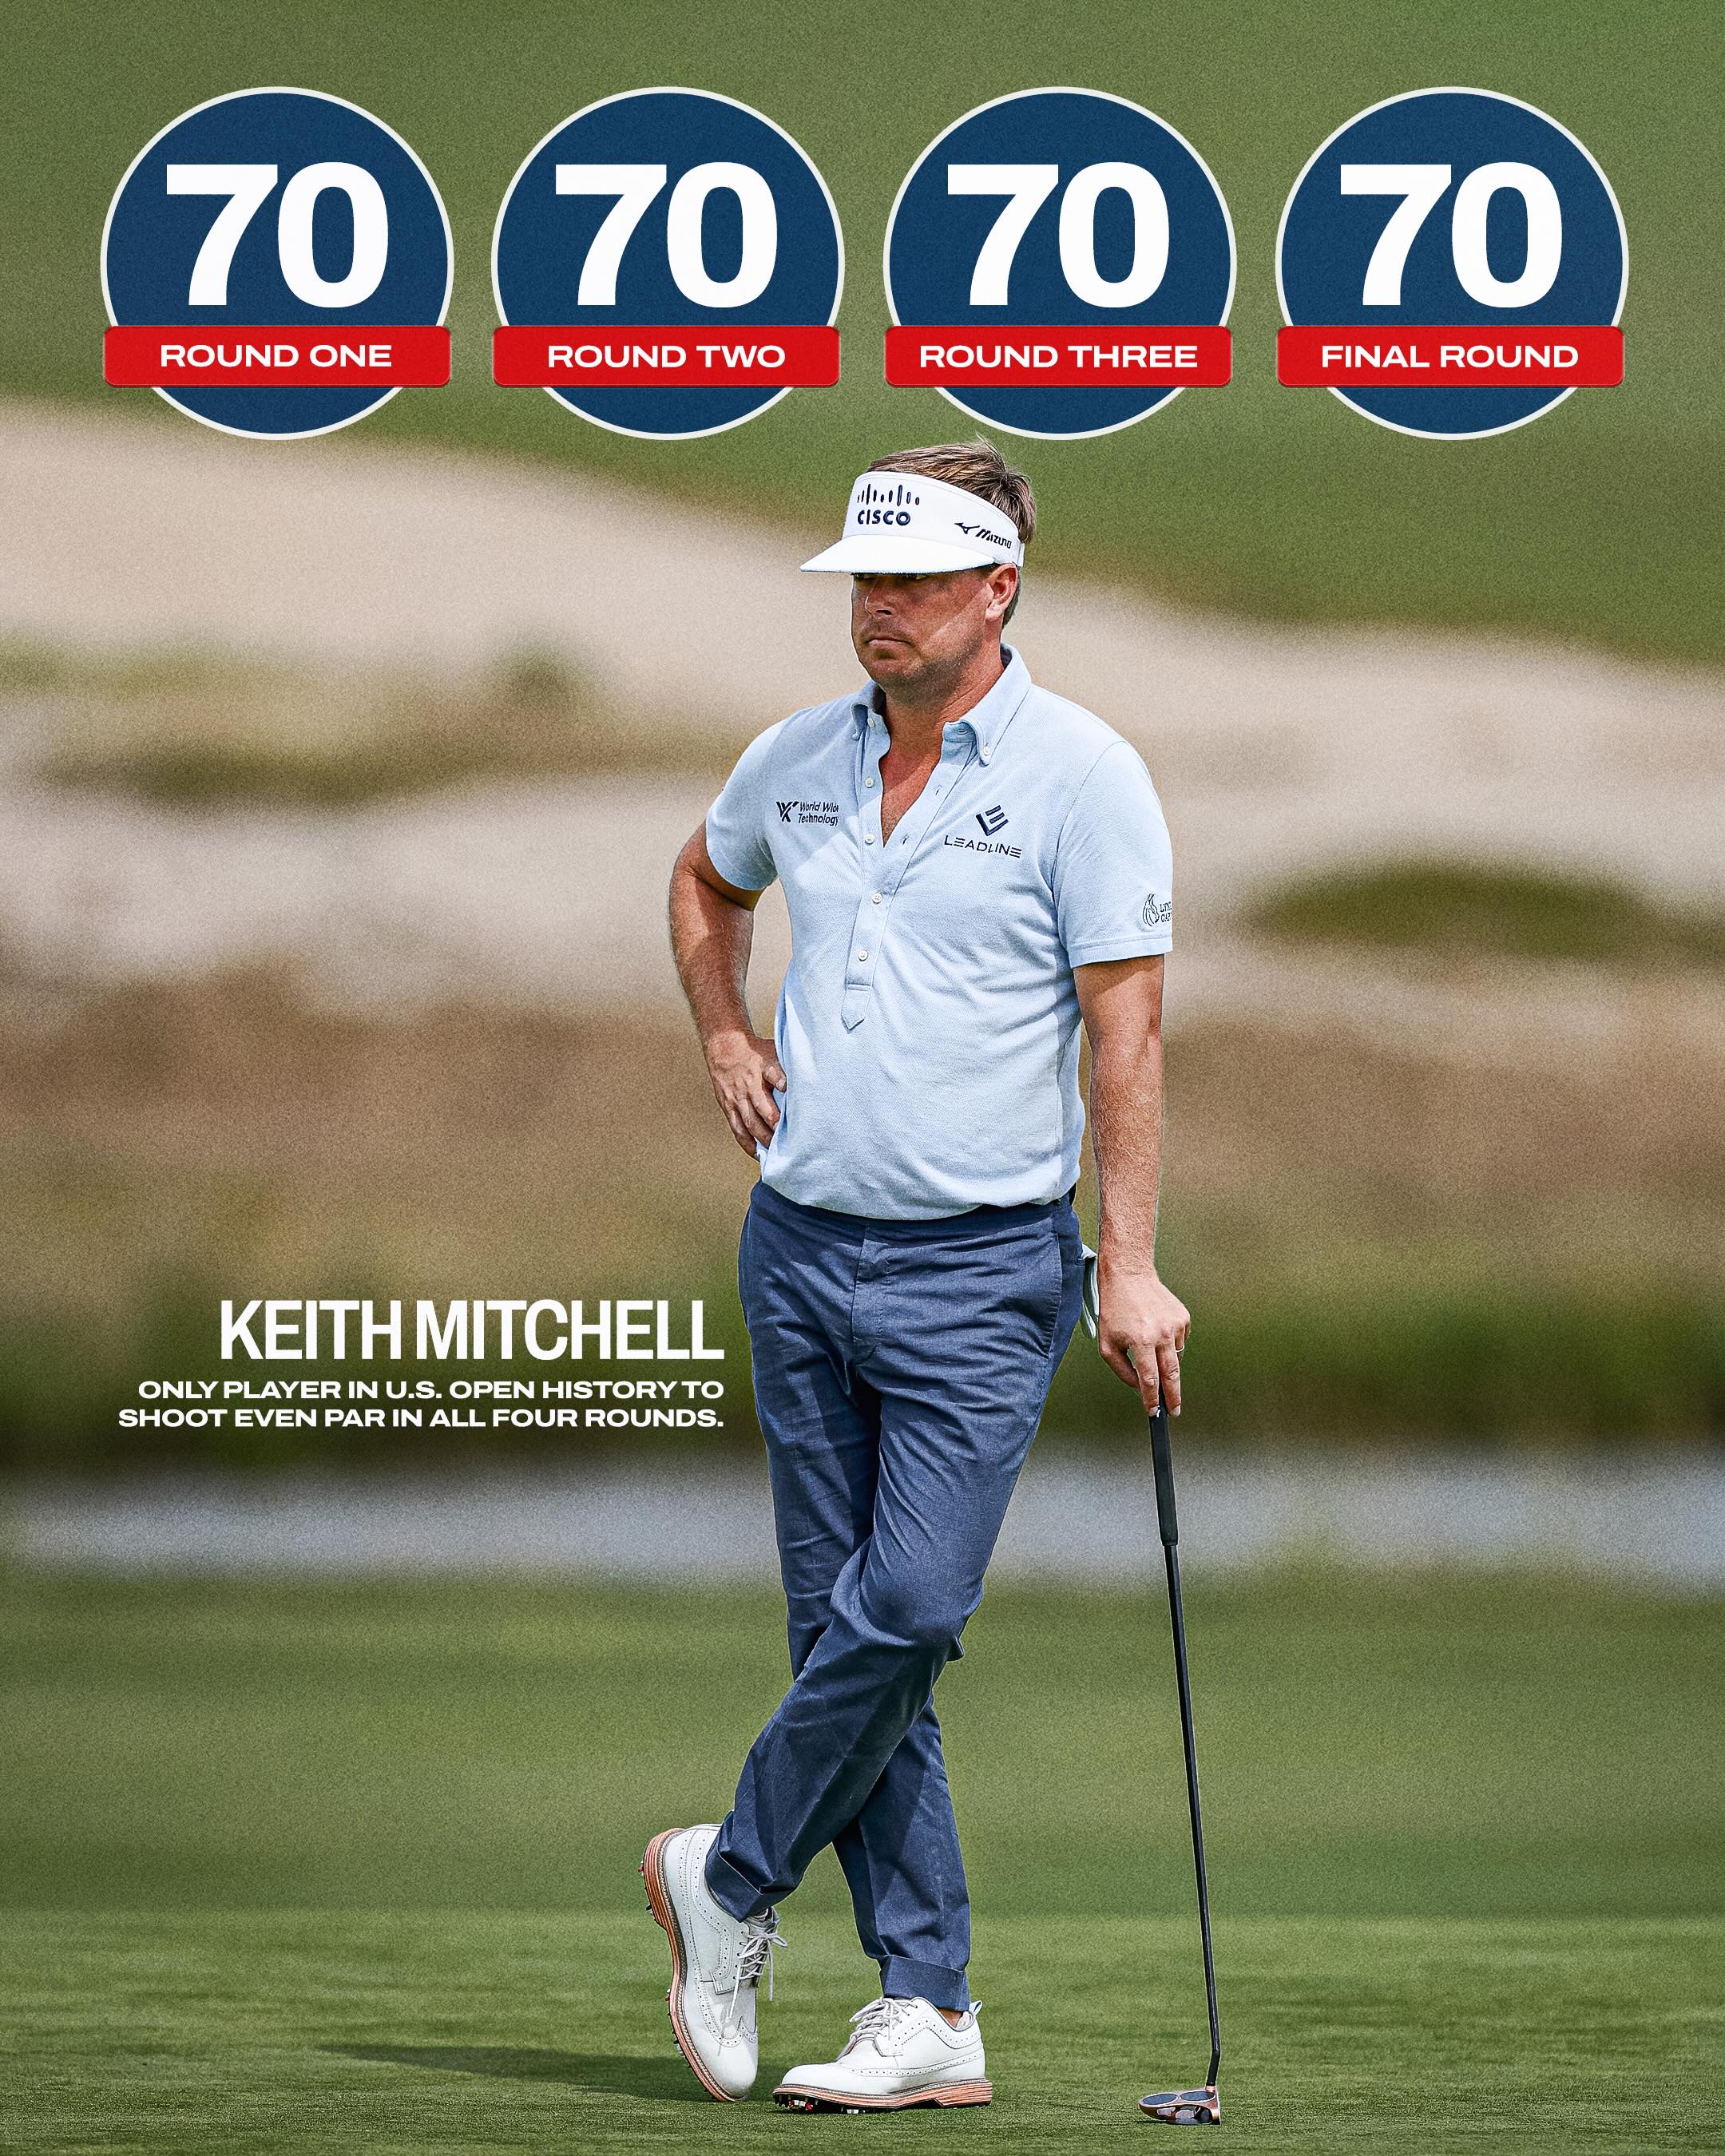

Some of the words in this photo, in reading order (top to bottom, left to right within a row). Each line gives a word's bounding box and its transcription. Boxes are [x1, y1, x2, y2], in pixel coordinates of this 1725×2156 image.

[799, 801, 821, 812] World
[798, 813, 839, 826] Technology
[944, 834, 1022, 858] LEADLINE
